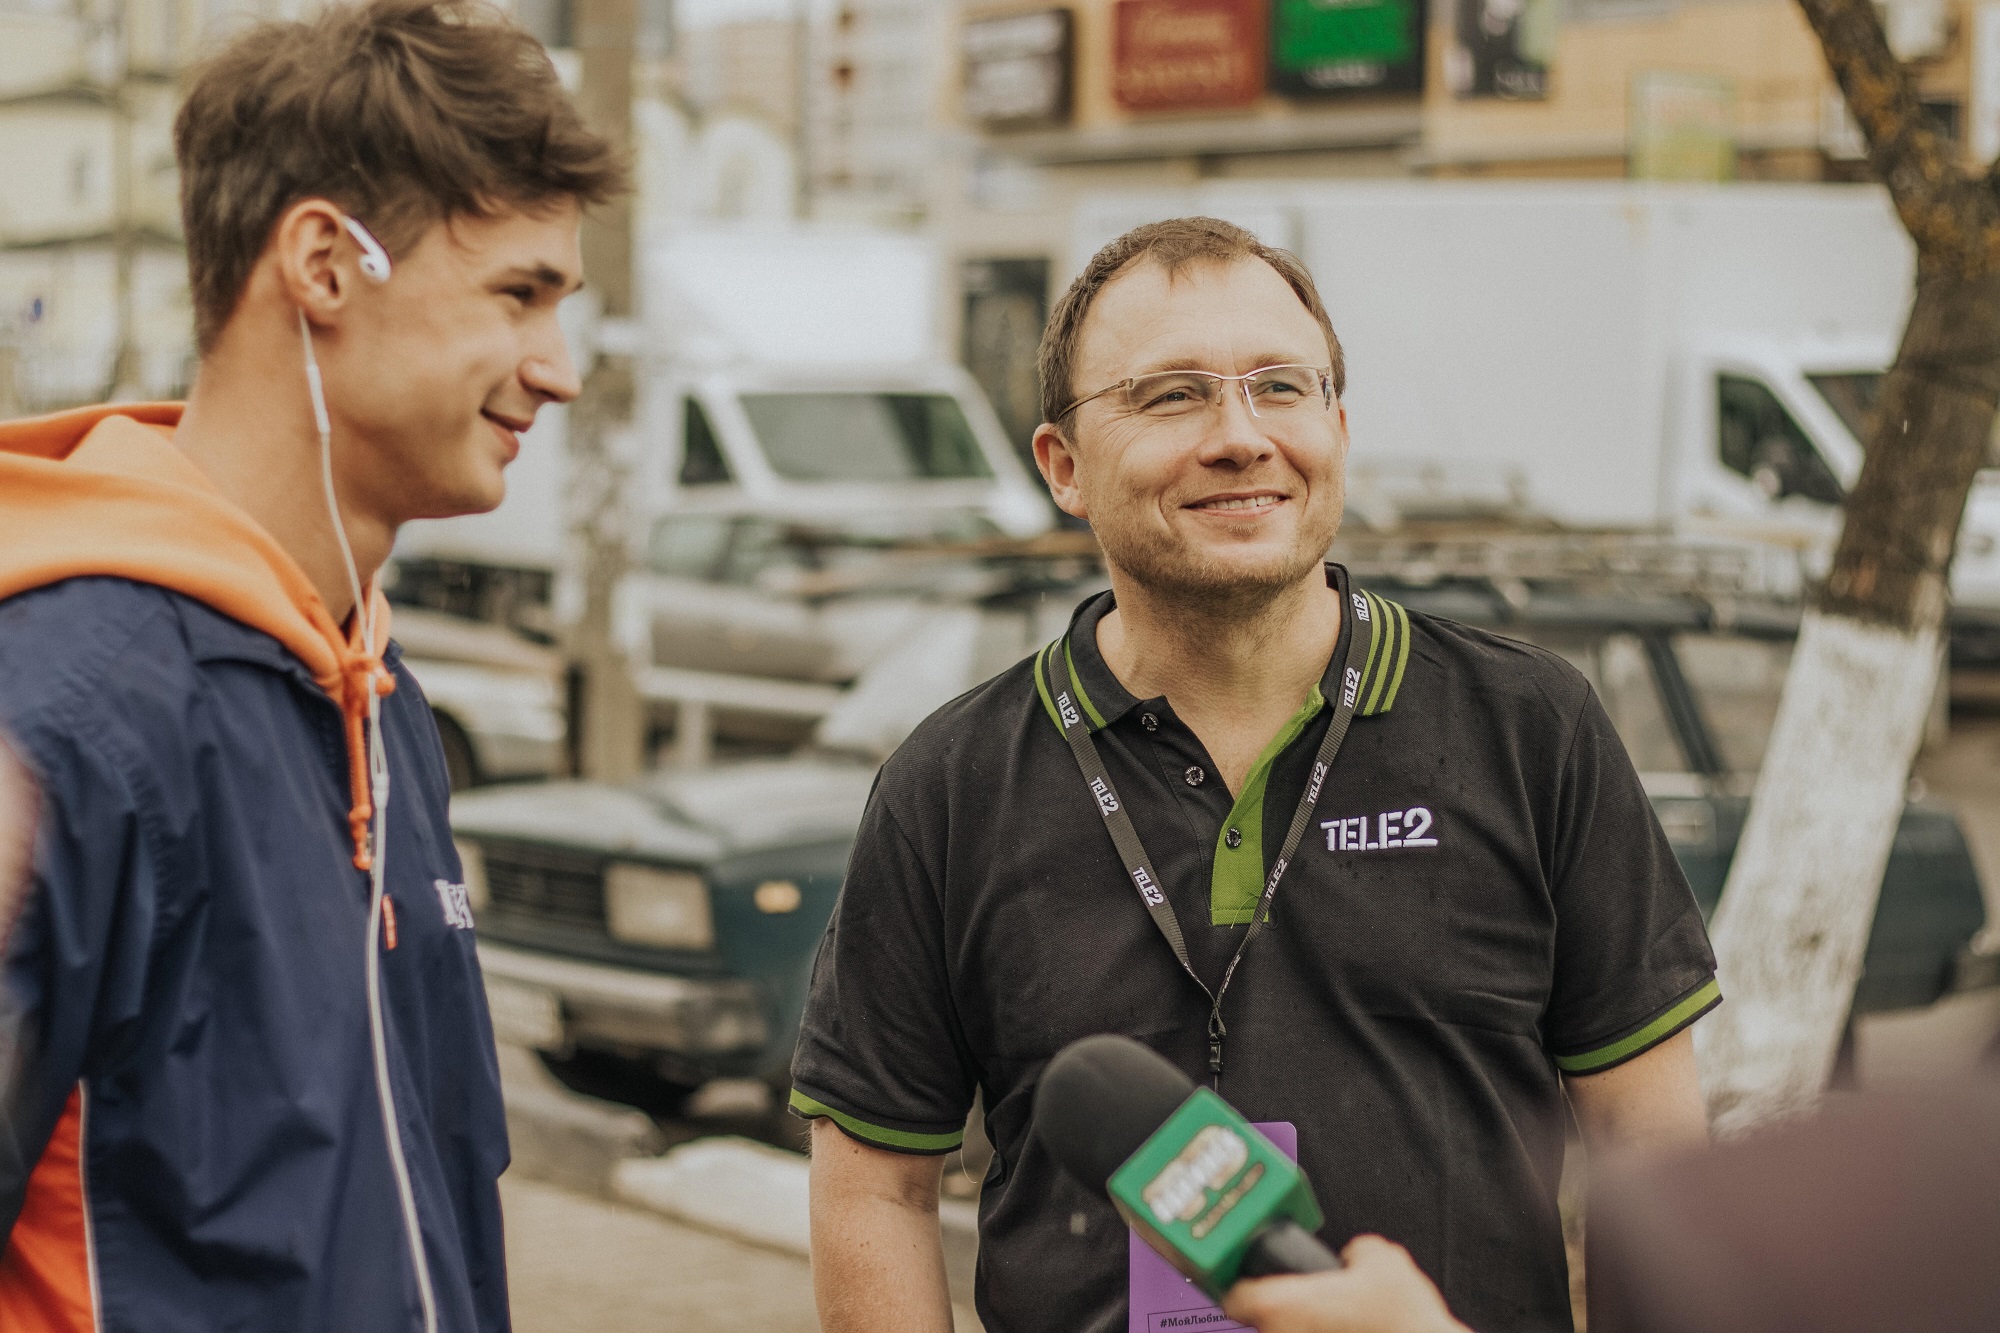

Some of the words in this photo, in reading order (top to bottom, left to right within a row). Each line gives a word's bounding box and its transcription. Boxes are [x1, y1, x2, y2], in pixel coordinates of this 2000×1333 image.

[1351, 593, 1370, 622] TELE2
[1343, 667, 1361, 708] TELE2
[1057, 691, 1080, 729] TELE2
[1090, 776, 1119, 817] TELE2
[1307, 761, 1328, 804] TELE2
[1320, 807, 1439, 852] TELE2
[1132, 866, 1164, 907] TELE2
[1264, 858, 1288, 900] TELE2
[1159, 1313, 1229, 1329] #МойЛюбим
